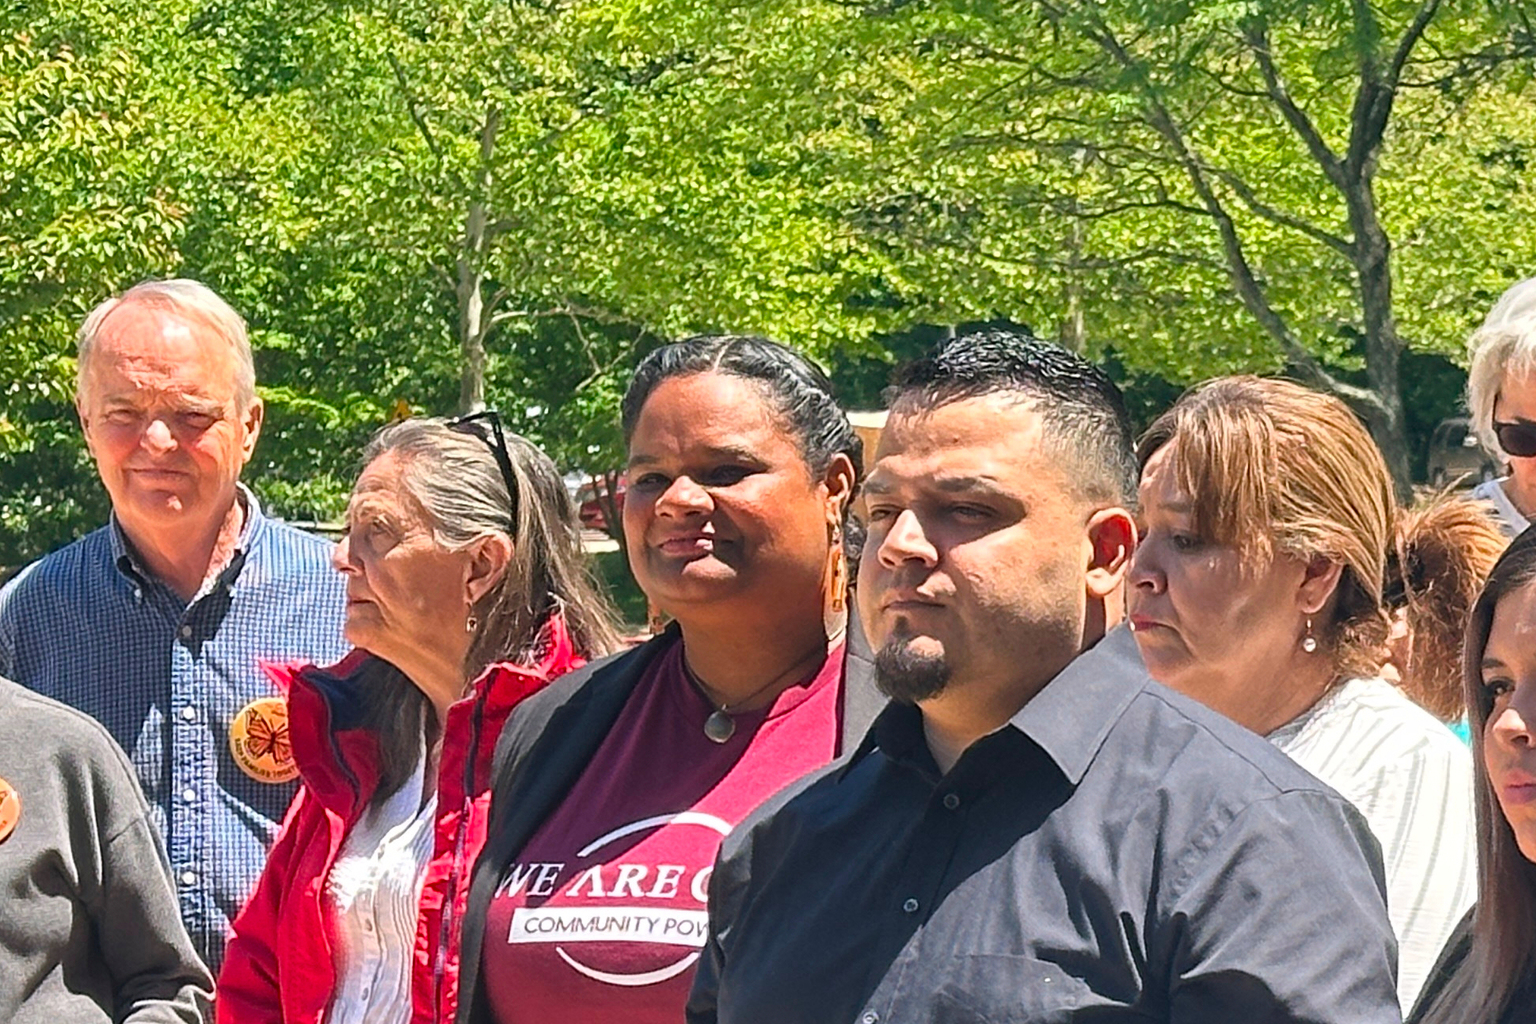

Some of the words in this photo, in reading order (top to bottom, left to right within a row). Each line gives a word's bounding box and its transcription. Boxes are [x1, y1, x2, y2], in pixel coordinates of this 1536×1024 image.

[494, 863, 566, 899] WE
[566, 864, 686, 899] ARE
[524, 915, 660, 935] COMMUNITY
